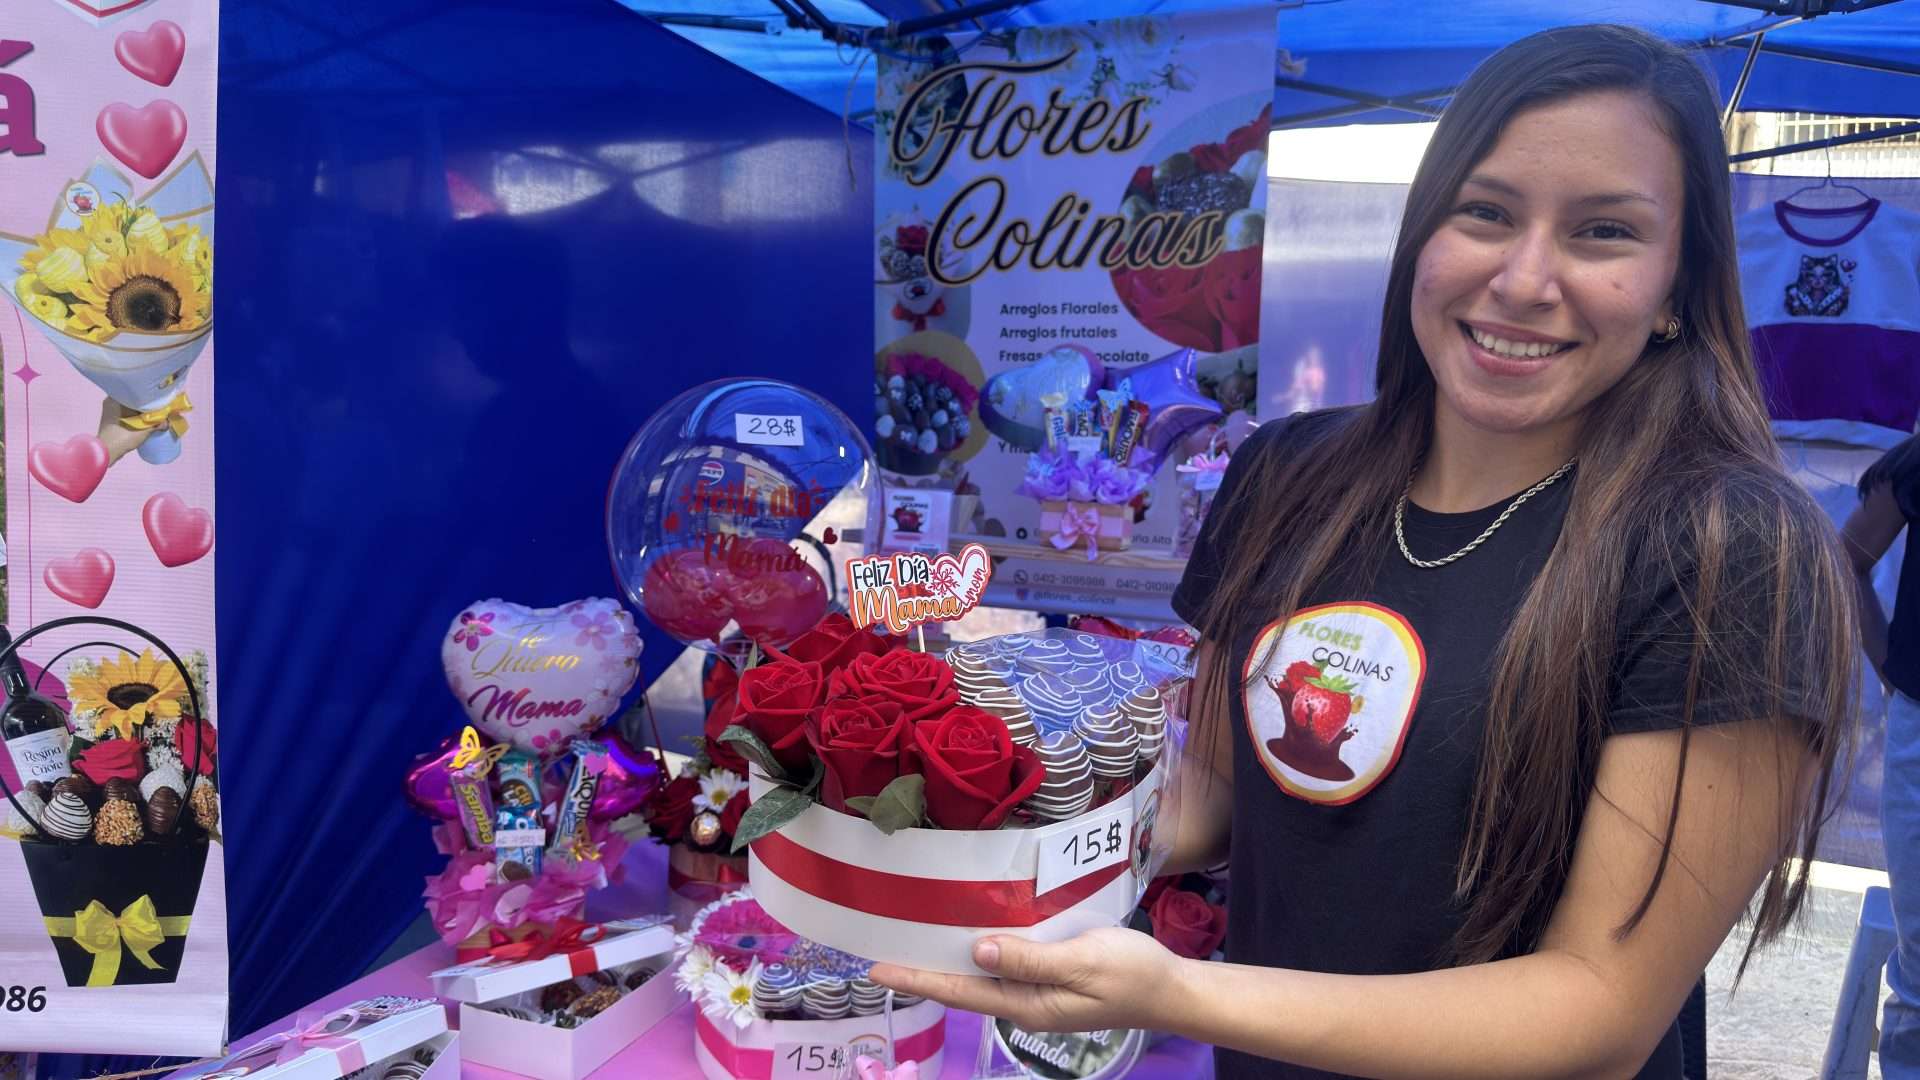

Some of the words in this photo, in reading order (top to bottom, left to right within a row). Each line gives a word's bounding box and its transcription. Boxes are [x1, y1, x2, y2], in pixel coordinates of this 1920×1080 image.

[893, 49, 1151, 187] Flores
[927, 177, 1225, 285] Colinas
[1000, 303, 1057, 319] Arreglos
[1061, 302, 1119, 315] Florales
[1000, 327, 1057, 342] Arreglos
[1060, 326, 1118, 338] frutales
[748, 418, 796, 437] 28$
[853, 560, 892, 590] Feliz
[898, 557, 929, 586] Día
[965, 566, 987, 602] mom
[1298, 621, 1363, 651] FLORES
[472, 639, 582, 679] Quiero
[1312, 647, 1394, 682] COLINAS
[468, 684, 586, 727] Mama
[460, 783, 494, 844] Samba
[1063, 819, 1122, 866] 15$
[1009, 1027, 1070, 1069] mundo
